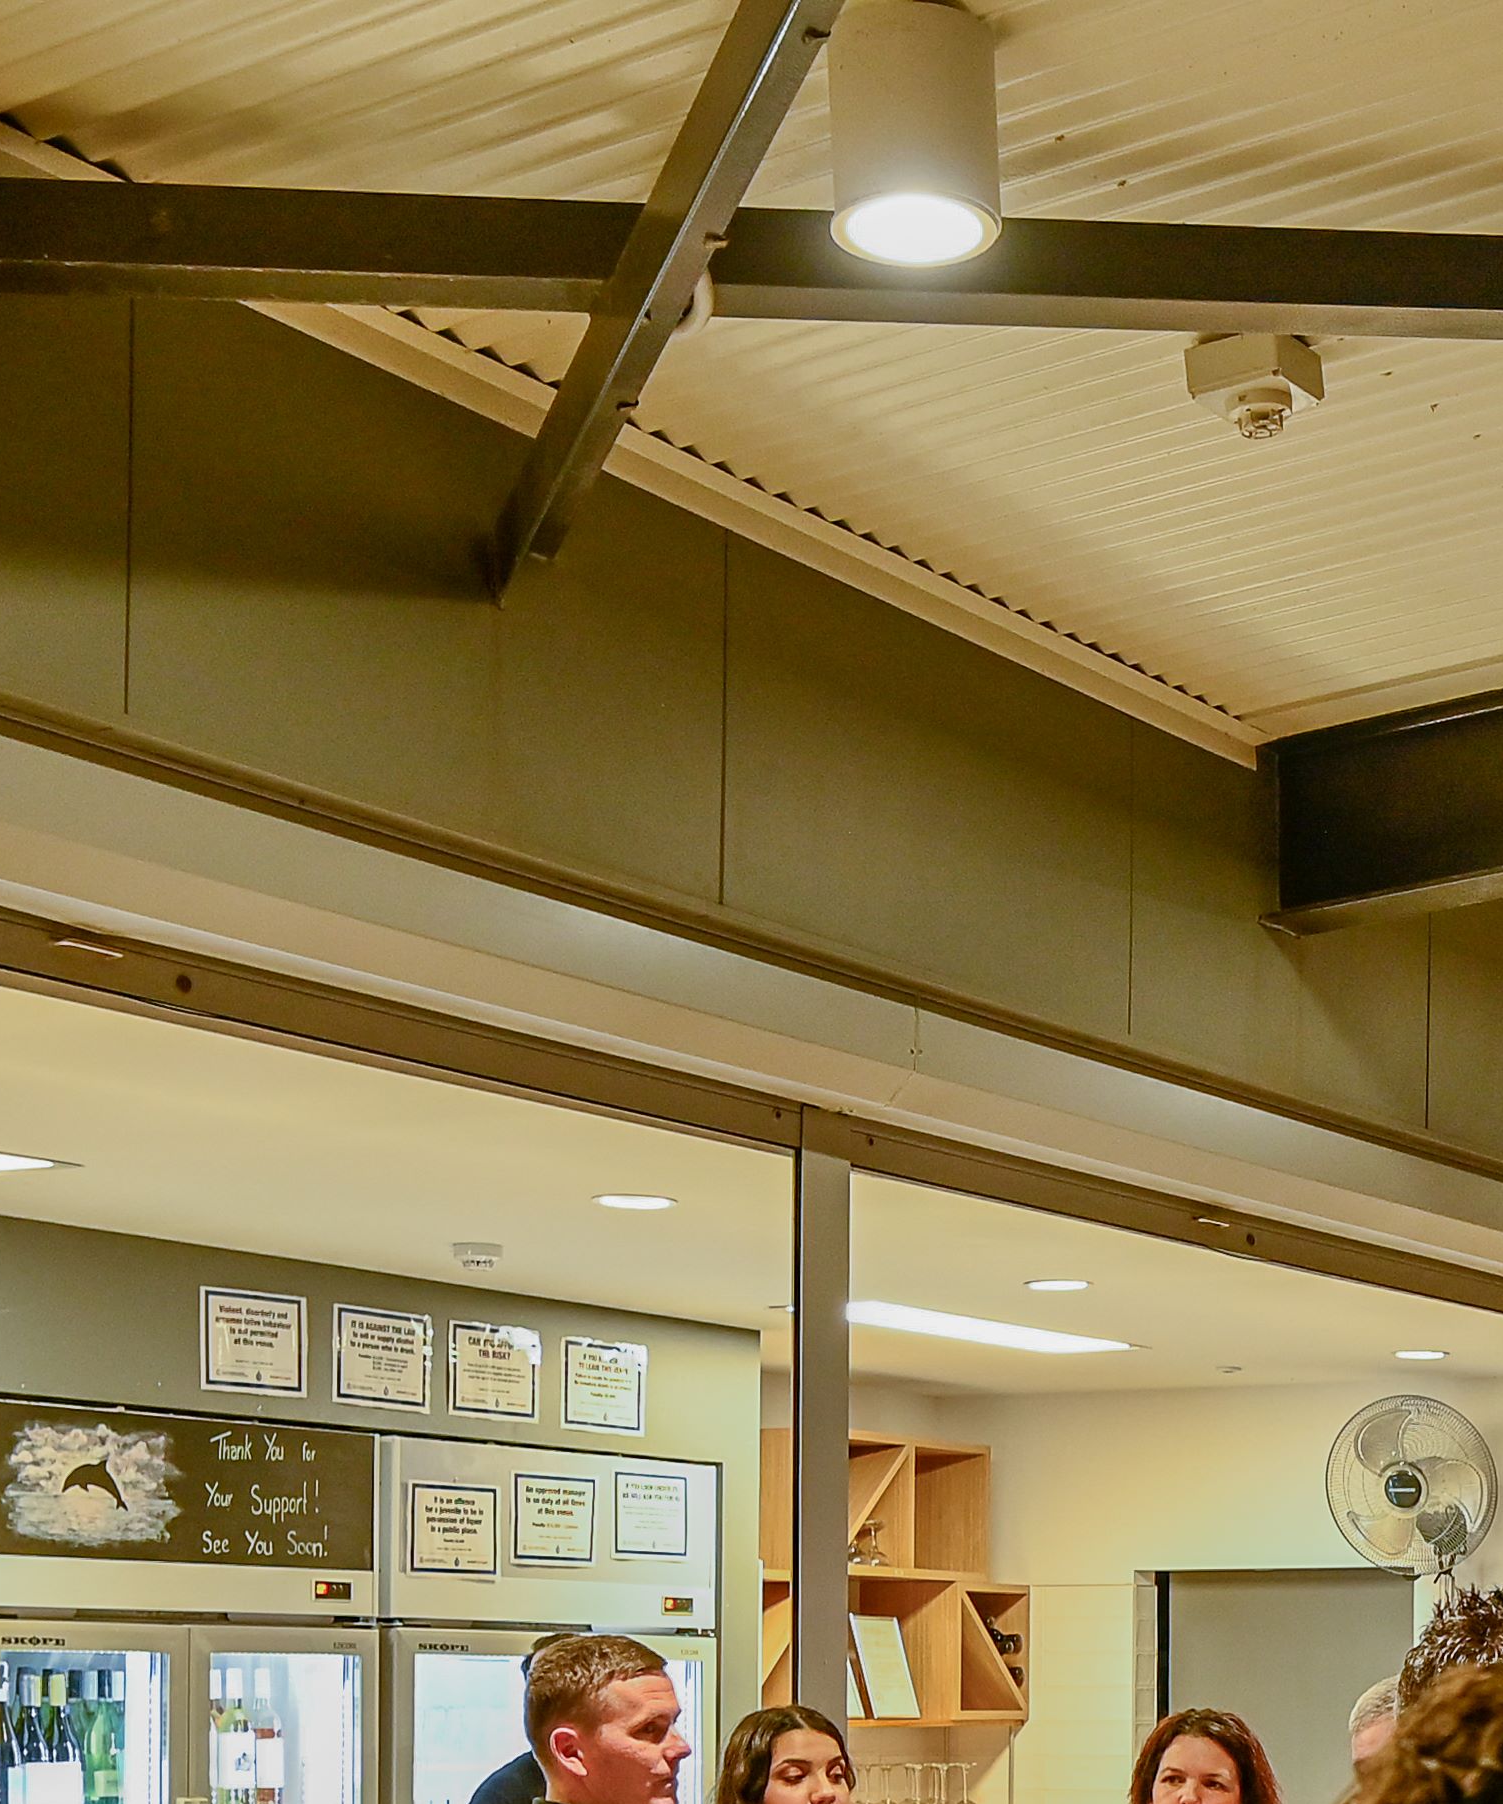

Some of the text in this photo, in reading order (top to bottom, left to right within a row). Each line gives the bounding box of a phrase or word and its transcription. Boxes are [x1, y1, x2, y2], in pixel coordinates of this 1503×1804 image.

[366, 1322, 390, 1333] AGAINST
[210, 1430, 316, 1462] Thank You for
[205, 1481, 234, 1508] Your
[202, 1525, 328, 1558] See You Soon!
[1, 1635, 66, 1647] SKOPE
[418, 1642, 469, 1652] SKOPE
